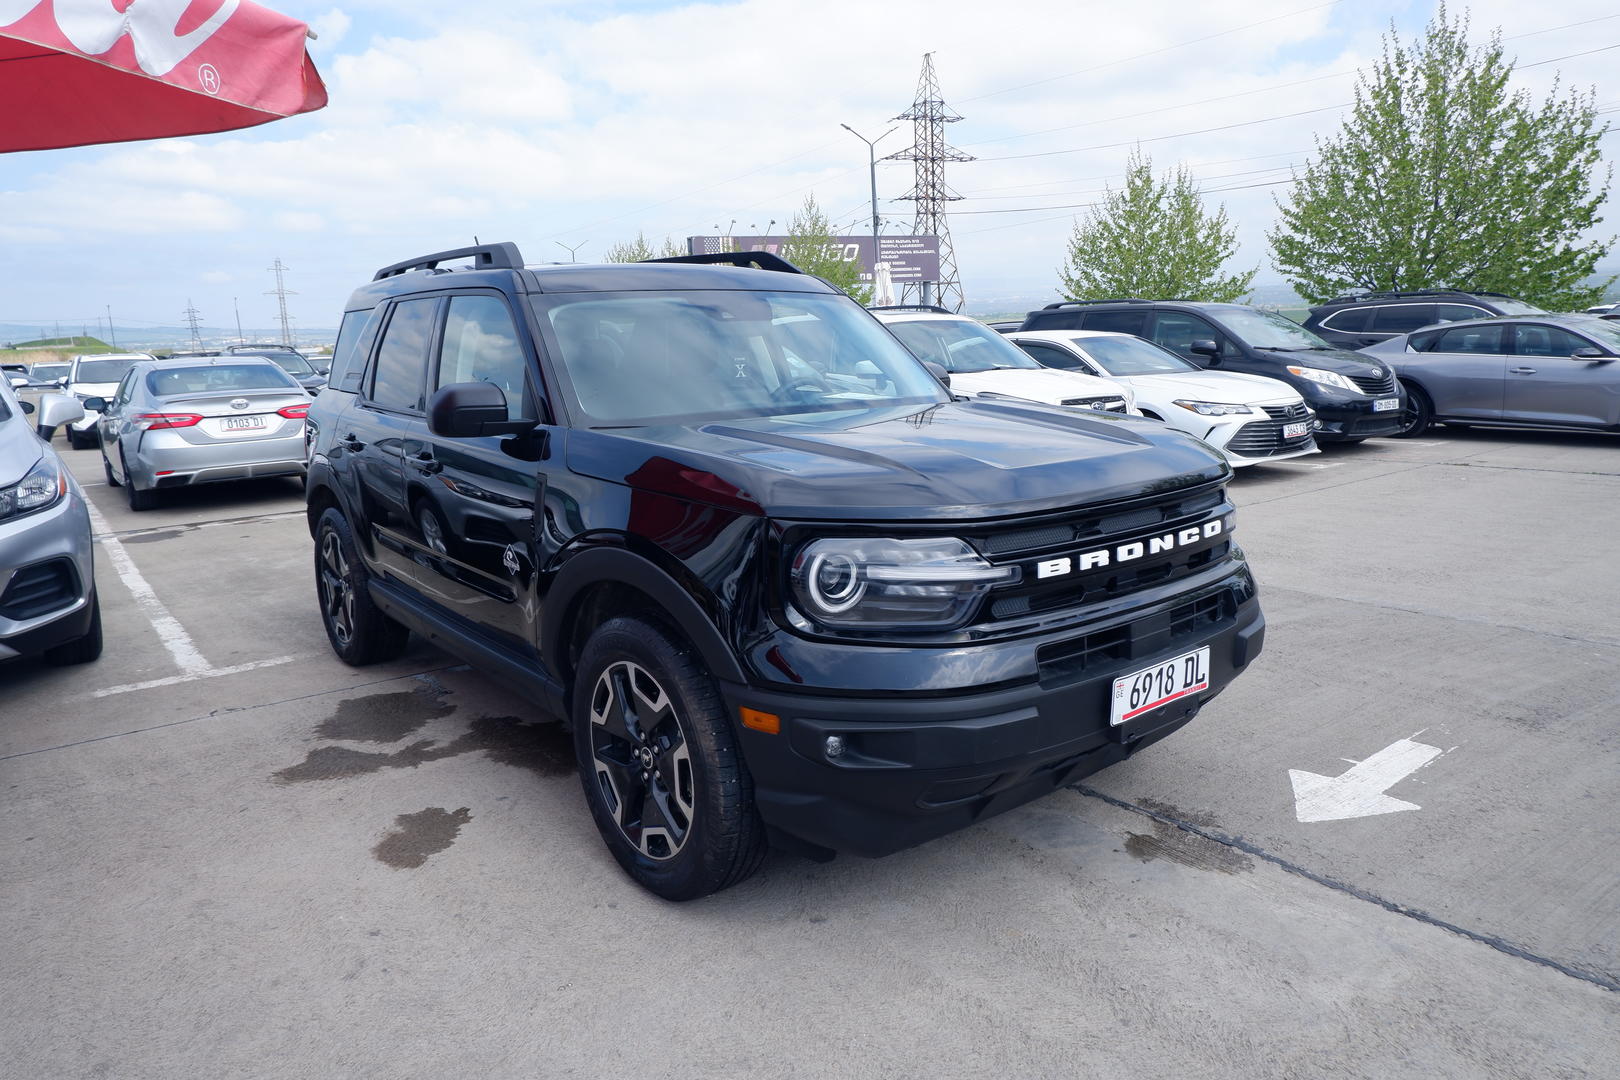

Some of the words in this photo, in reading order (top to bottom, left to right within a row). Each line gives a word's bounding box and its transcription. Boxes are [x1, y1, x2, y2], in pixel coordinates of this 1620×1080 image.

[1037, 519, 1222, 579] BRONCO
[1130, 663, 1175, 710] 6918
[1183, 651, 1206, 689] DL
